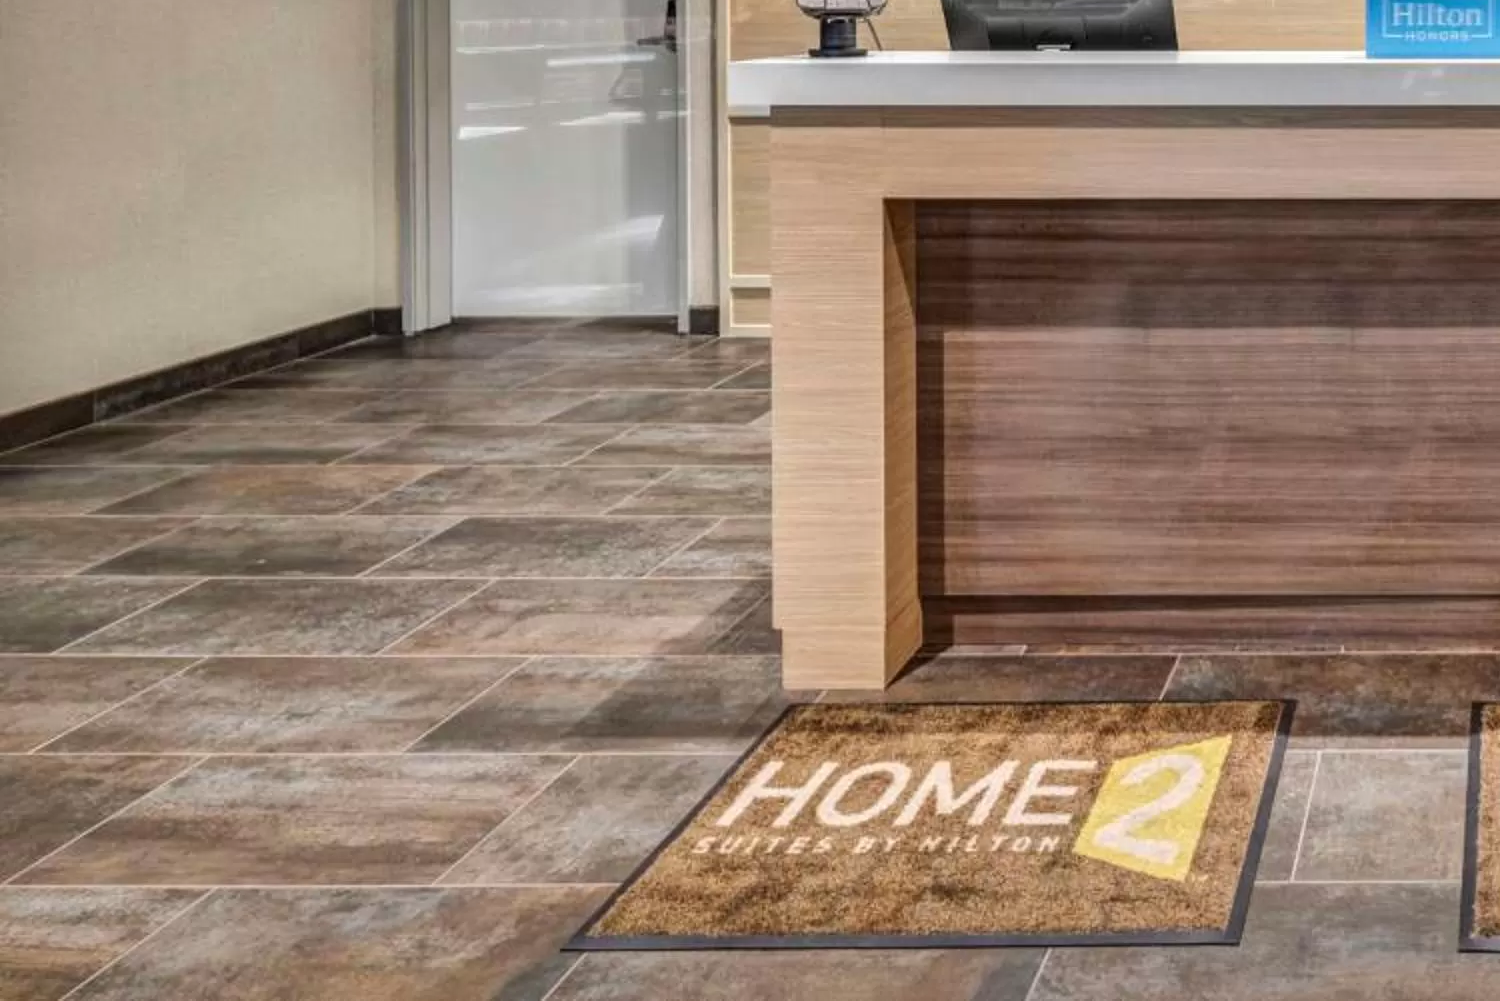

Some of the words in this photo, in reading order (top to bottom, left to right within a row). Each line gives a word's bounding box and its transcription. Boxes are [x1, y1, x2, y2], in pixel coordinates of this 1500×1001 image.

[1391, 2, 1484, 27] Hilton
[691, 836, 834, 855] SUITES
[852, 836, 900, 855] BY
[917, 835, 1062, 853] HILTON
